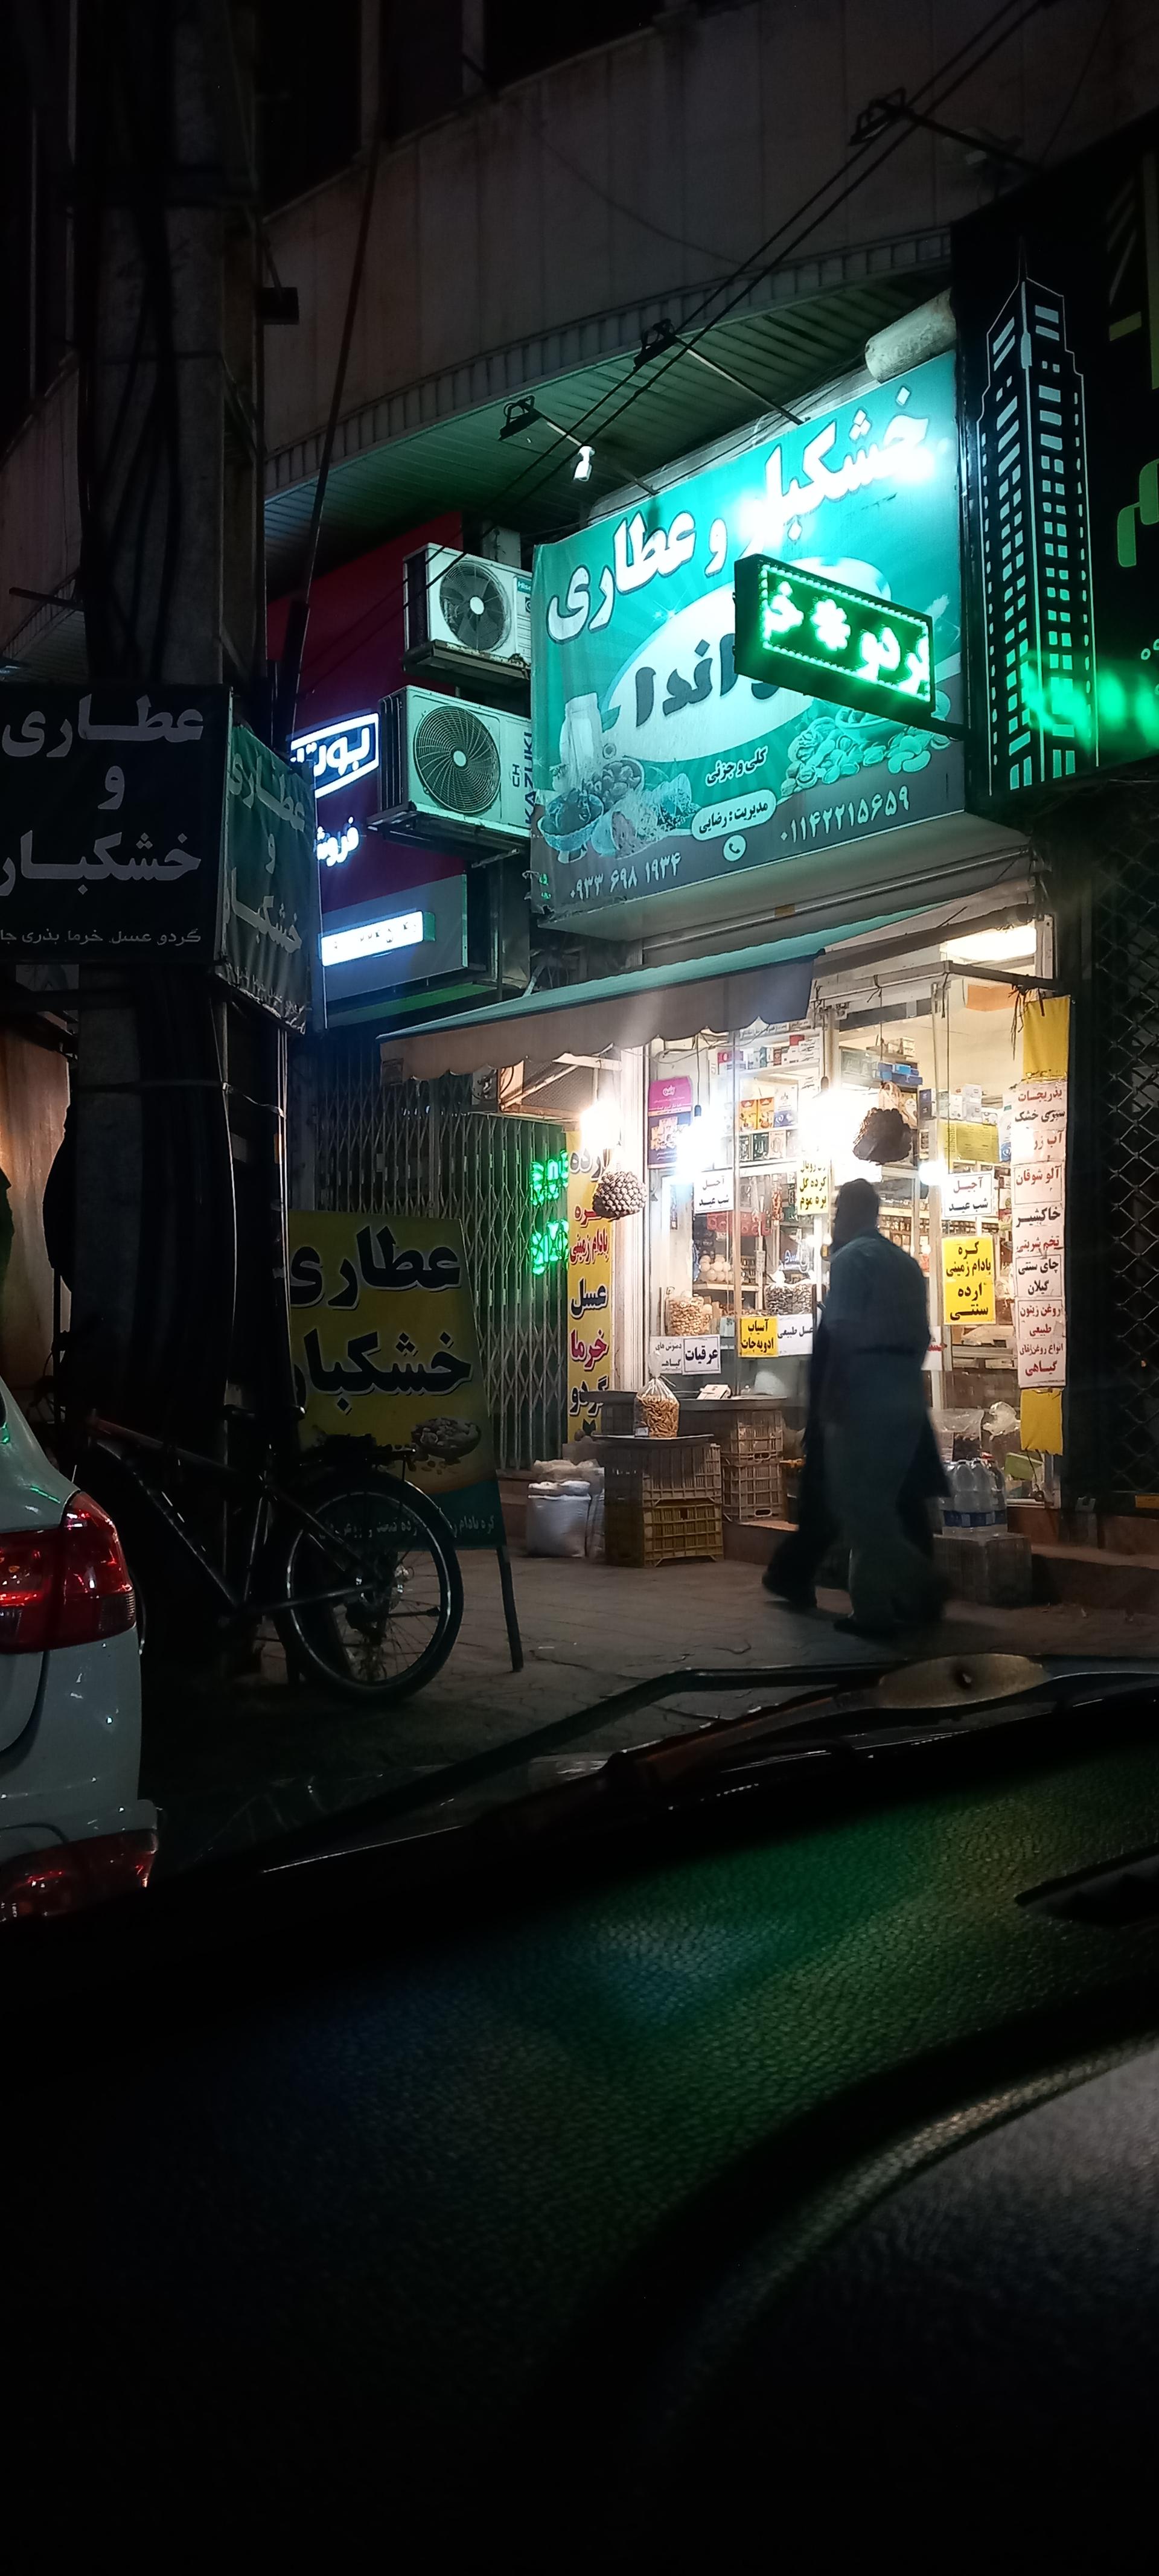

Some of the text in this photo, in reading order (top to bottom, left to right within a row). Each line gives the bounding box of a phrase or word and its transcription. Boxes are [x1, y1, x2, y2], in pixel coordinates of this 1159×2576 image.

[704, 517, 728, 578] و
[546, 510, 697, 645] عطاری
[2, 694, 203, 757] عطاری
[737, 762, 743, 775] و
[745, 747, 767, 773] کلی
[512, 763, 520, 788] CH
[523, 732, 537, 825] KAZUKI
[98, 765, 125, 810] و
[229, 753, 305, 833] عطاری
[699, 811, 727, 834] رضایی
[0, 829, 202, 896] خشکبار
[266, 833, 276, 874] و
[570, 873, 604, 900] ۰۹۳۳
[610, 866, 638, 893] ۶۹۸
[645, 852, 681, 883] ۱۹۳۴
[0, 930, 17, 945] جا
[1015, 1109, 1038, 1122] خشک
[1047, 1129, 1064, 1148] آب
[1045, 1163, 1062, 1184] آلو
[953, 1176, 983, 1194] آجیل
[699, 1197, 716, 1208] عید
[948, 1198, 989, 1213] شب عید
[1015, 1206, 1062, 1228] خاکشیر
[957, 1241, 980, 1260] کره
[289, 1225, 461, 1309] عطاری
[945, 1257, 991, 1277] بادام زمینی
[1018, 1257, 1059, 1276] چای سنتی
[570, 1277, 608, 1318] عسل
[957, 1282, 983, 1302] ارده
[950, 1304, 989, 1322] سنتی
[1040, 1304, 1061, 1317] روغن
[747, 1318, 770, 1335] آسیاب
[777, 1326, 798, 1339] طبیعی
[1030, 1323, 1052, 1337] طبیعی
[570, 1329, 609, 1372] خرما
[685, 1345, 719, 1365] عرقیات
[1048, 1343, 1064, 1355] انواع
[293, 1328, 471, 1414] خشکبار
[661, 1358, 682, 1369] گیاه
[1025, 1360, 1058, 1377] گیاهی
